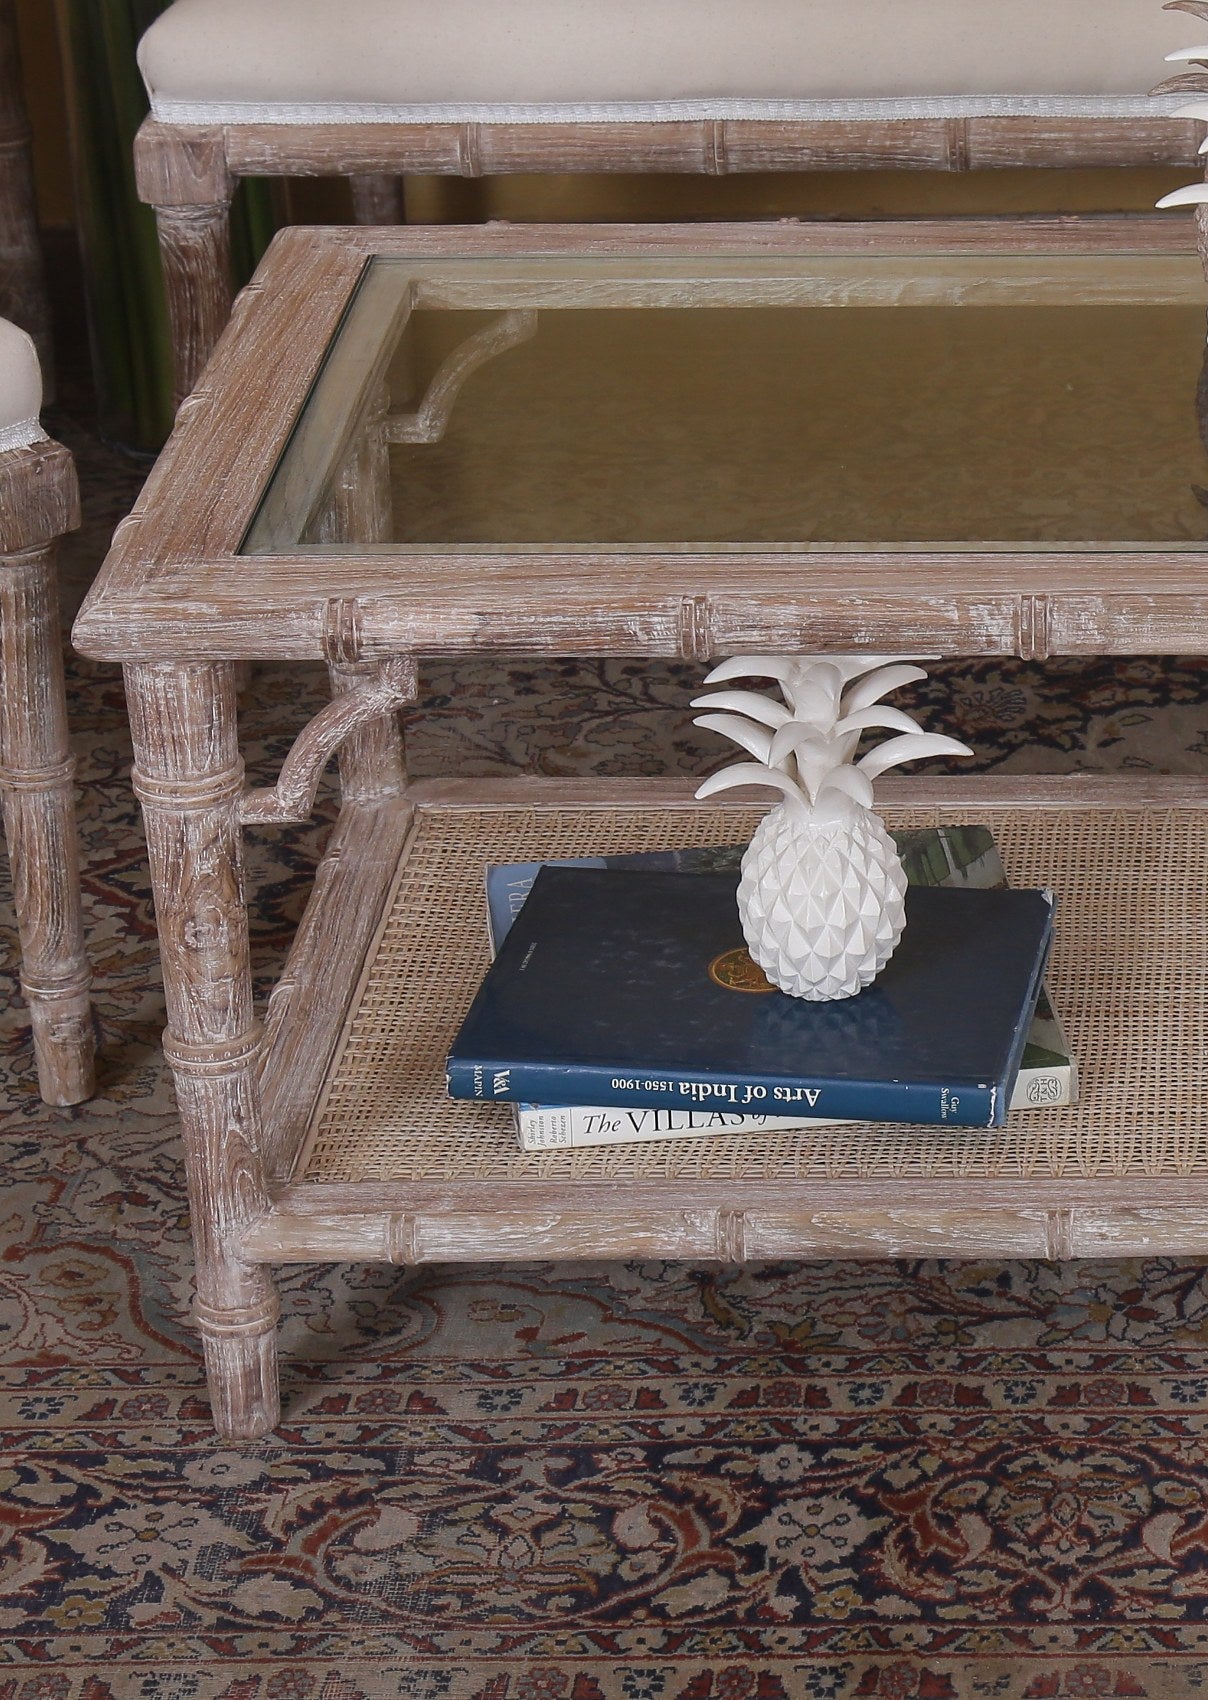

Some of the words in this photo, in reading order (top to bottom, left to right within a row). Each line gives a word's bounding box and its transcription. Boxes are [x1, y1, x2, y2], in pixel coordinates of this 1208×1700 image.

[473, 1064, 484, 1097] MAPIN
[611, 1078, 674, 1092] 1550-1900
[679, 1081, 738, 1104] India
[743, 1084, 767, 1104] of
[773, 1086, 822, 1107] Arts
[940, 1087, 950, 1120] Swallow
[950, 1096, 960, 1114] Guy
[527, 1119, 538, 1145] Shirley
[537, 1115, 547, 1148] Johnston
[549, 1116, 557, 1144] Roberto
[582, 1111, 622, 1134] The
[625, 1108, 746, 1133] VILLAS
